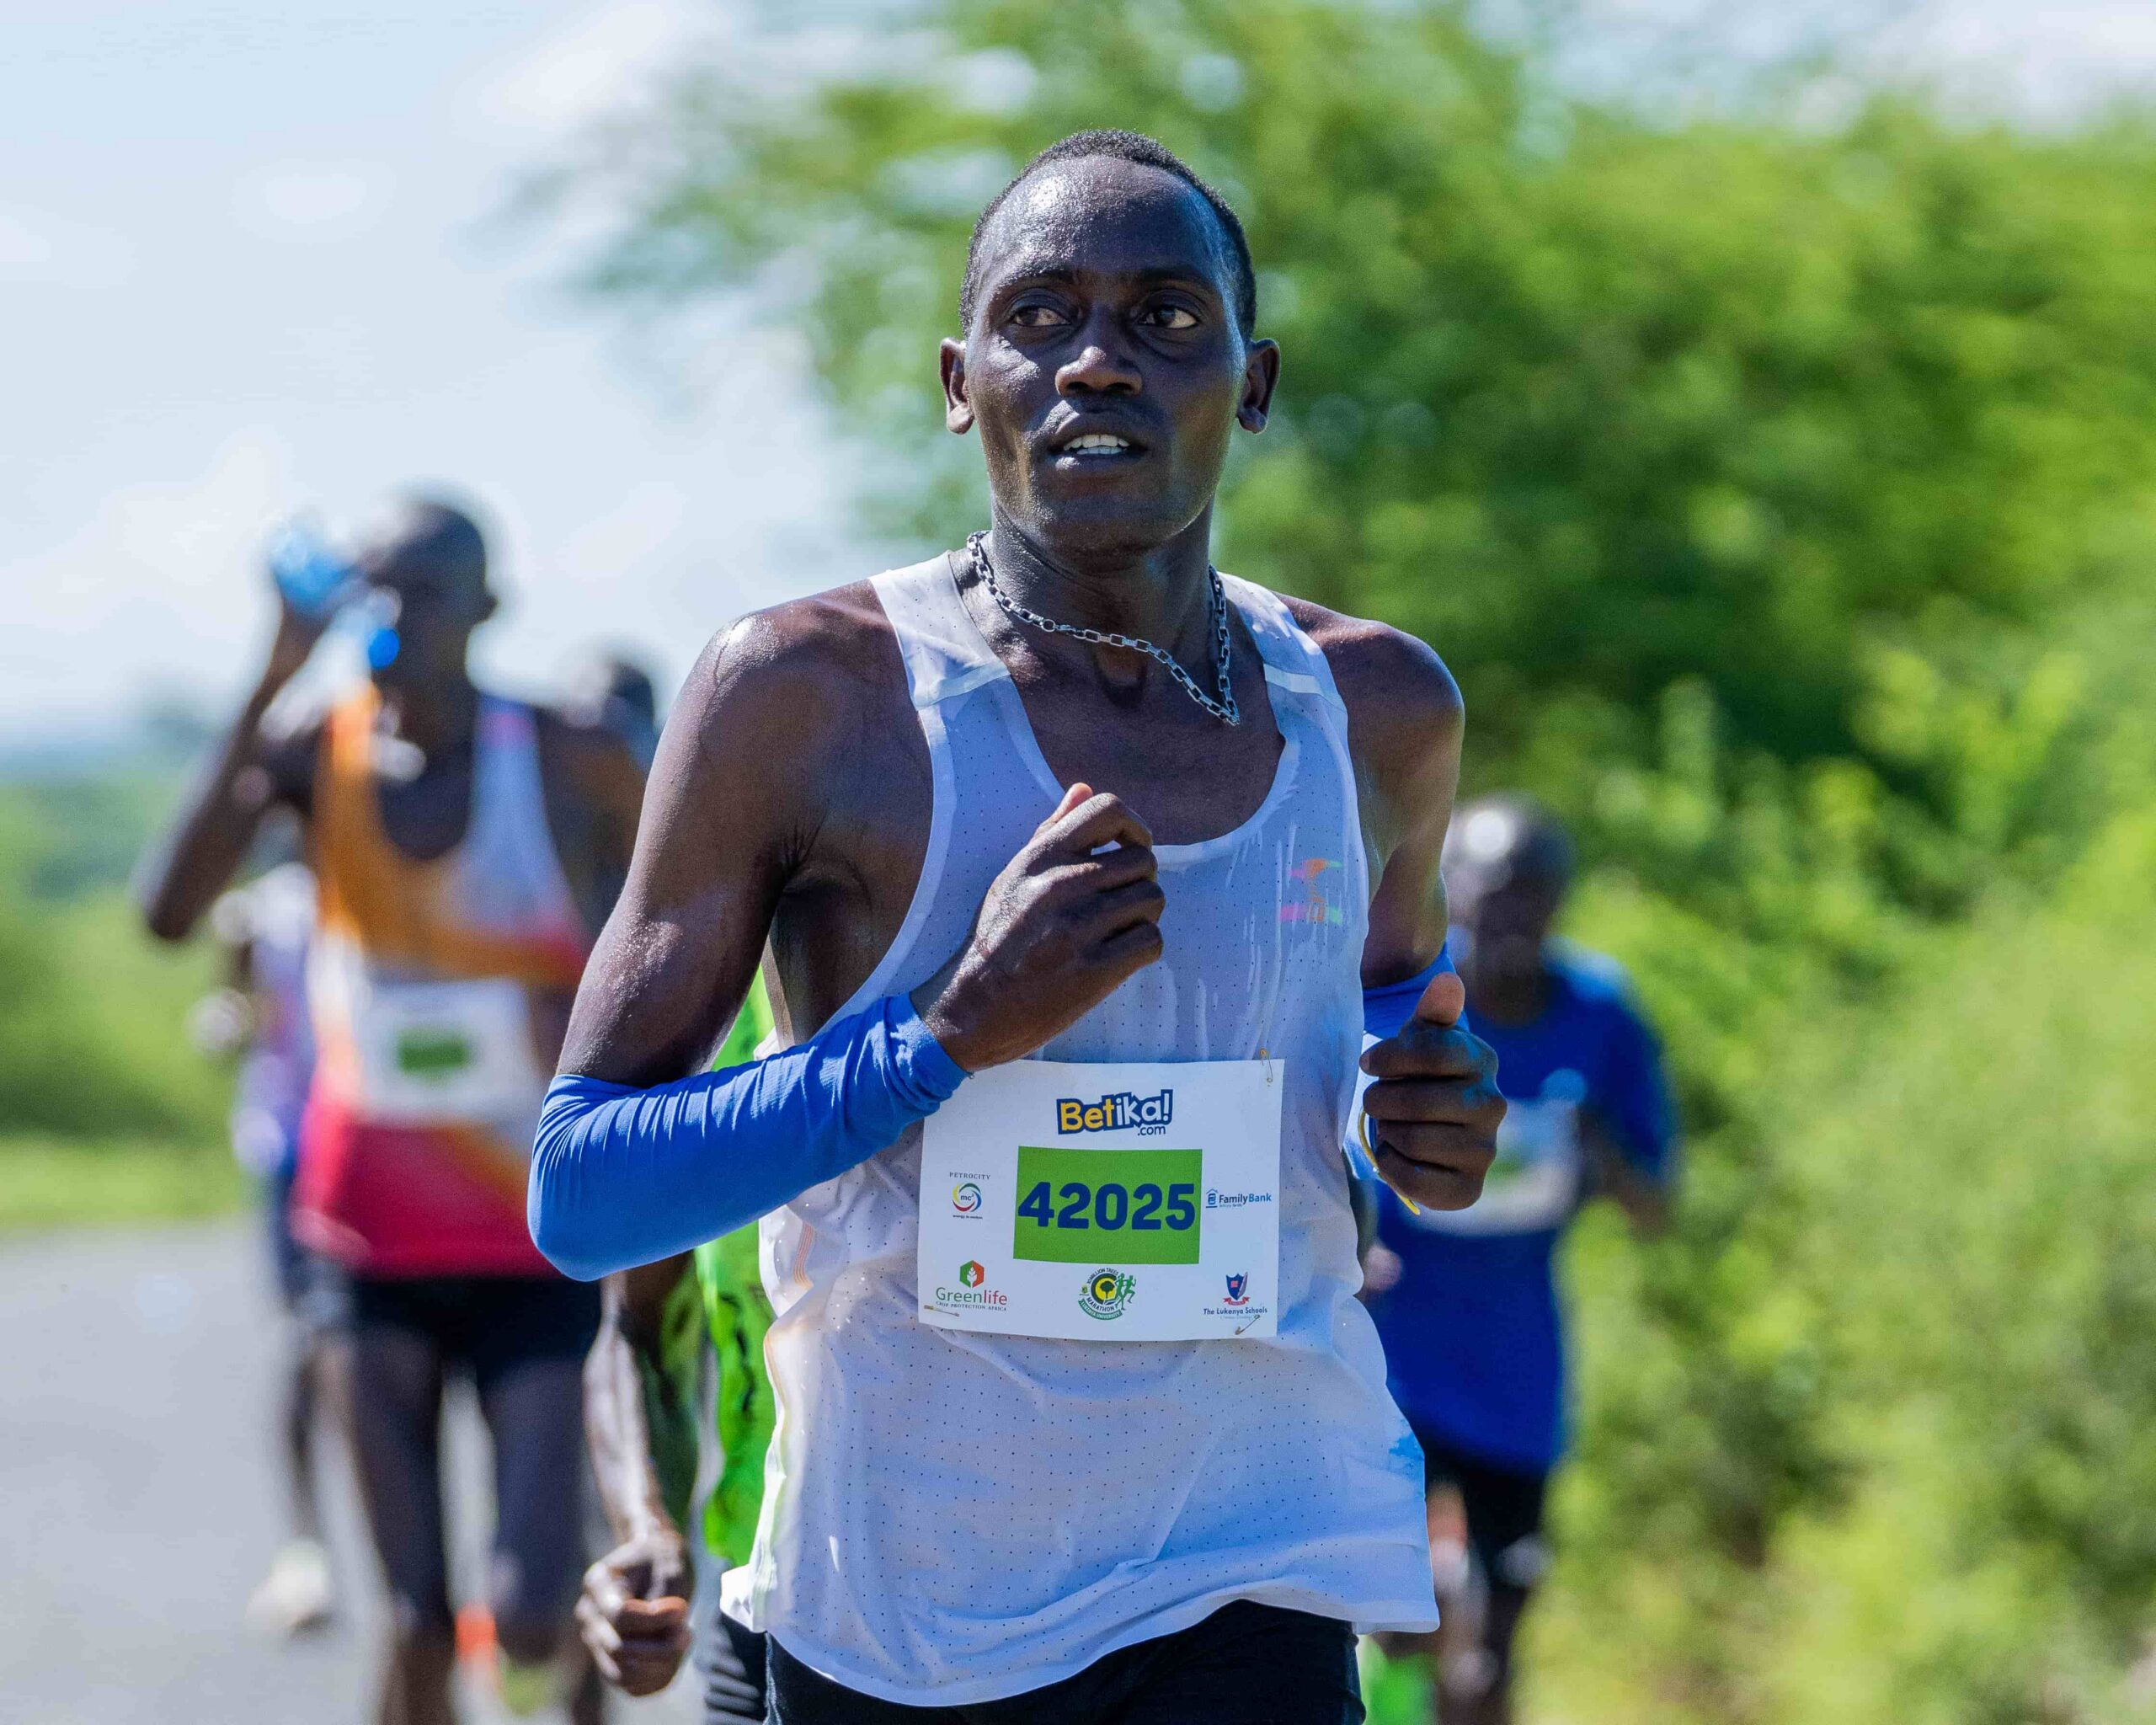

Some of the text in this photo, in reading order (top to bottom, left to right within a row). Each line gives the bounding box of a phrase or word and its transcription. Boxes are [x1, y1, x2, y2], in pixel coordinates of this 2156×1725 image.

[1058, 1091, 1171, 1133] Betika!
[1137, 1125, 1166, 1136] .com
[949, 1172, 990, 1180] PETROCITY
[1017, 1182, 1196, 1231] 42025
[936, 1287, 1008, 1306] Greenlife
[1086, 1297, 1115, 1311] MARATHON
[1216, 1307, 1244, 1316] Lukenya
